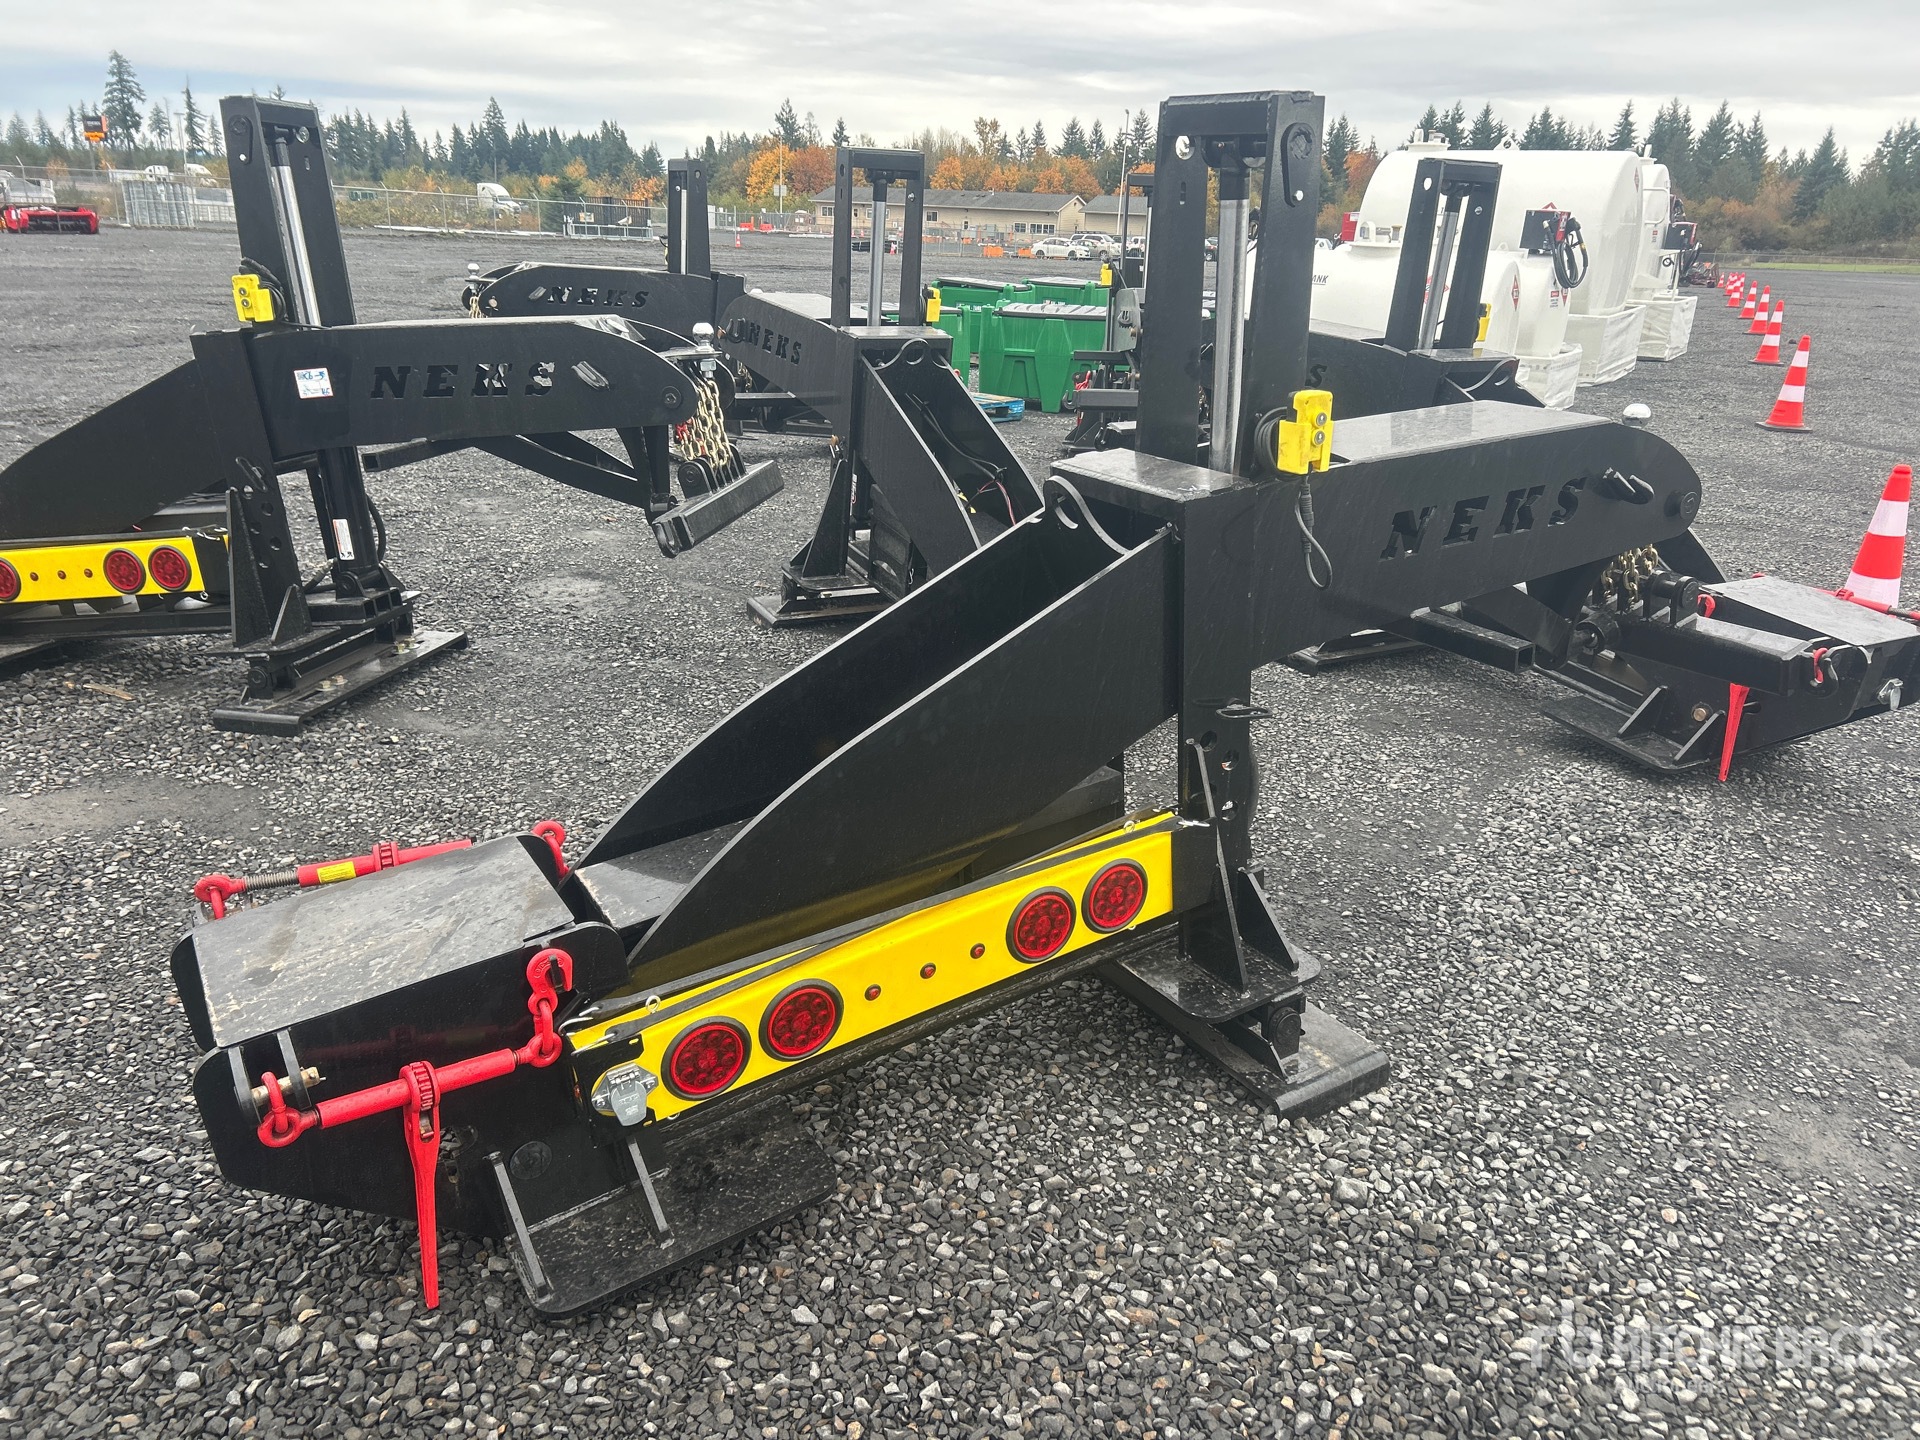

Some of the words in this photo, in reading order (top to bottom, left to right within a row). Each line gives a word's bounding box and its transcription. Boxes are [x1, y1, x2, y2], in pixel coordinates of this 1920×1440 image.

[547, 286, 649, 307] NEKS
[748, 322, 802, 366] NEKS
[370, 362, 556, 399] NEKS
[1379, 477, 1588, 562] NEKS
